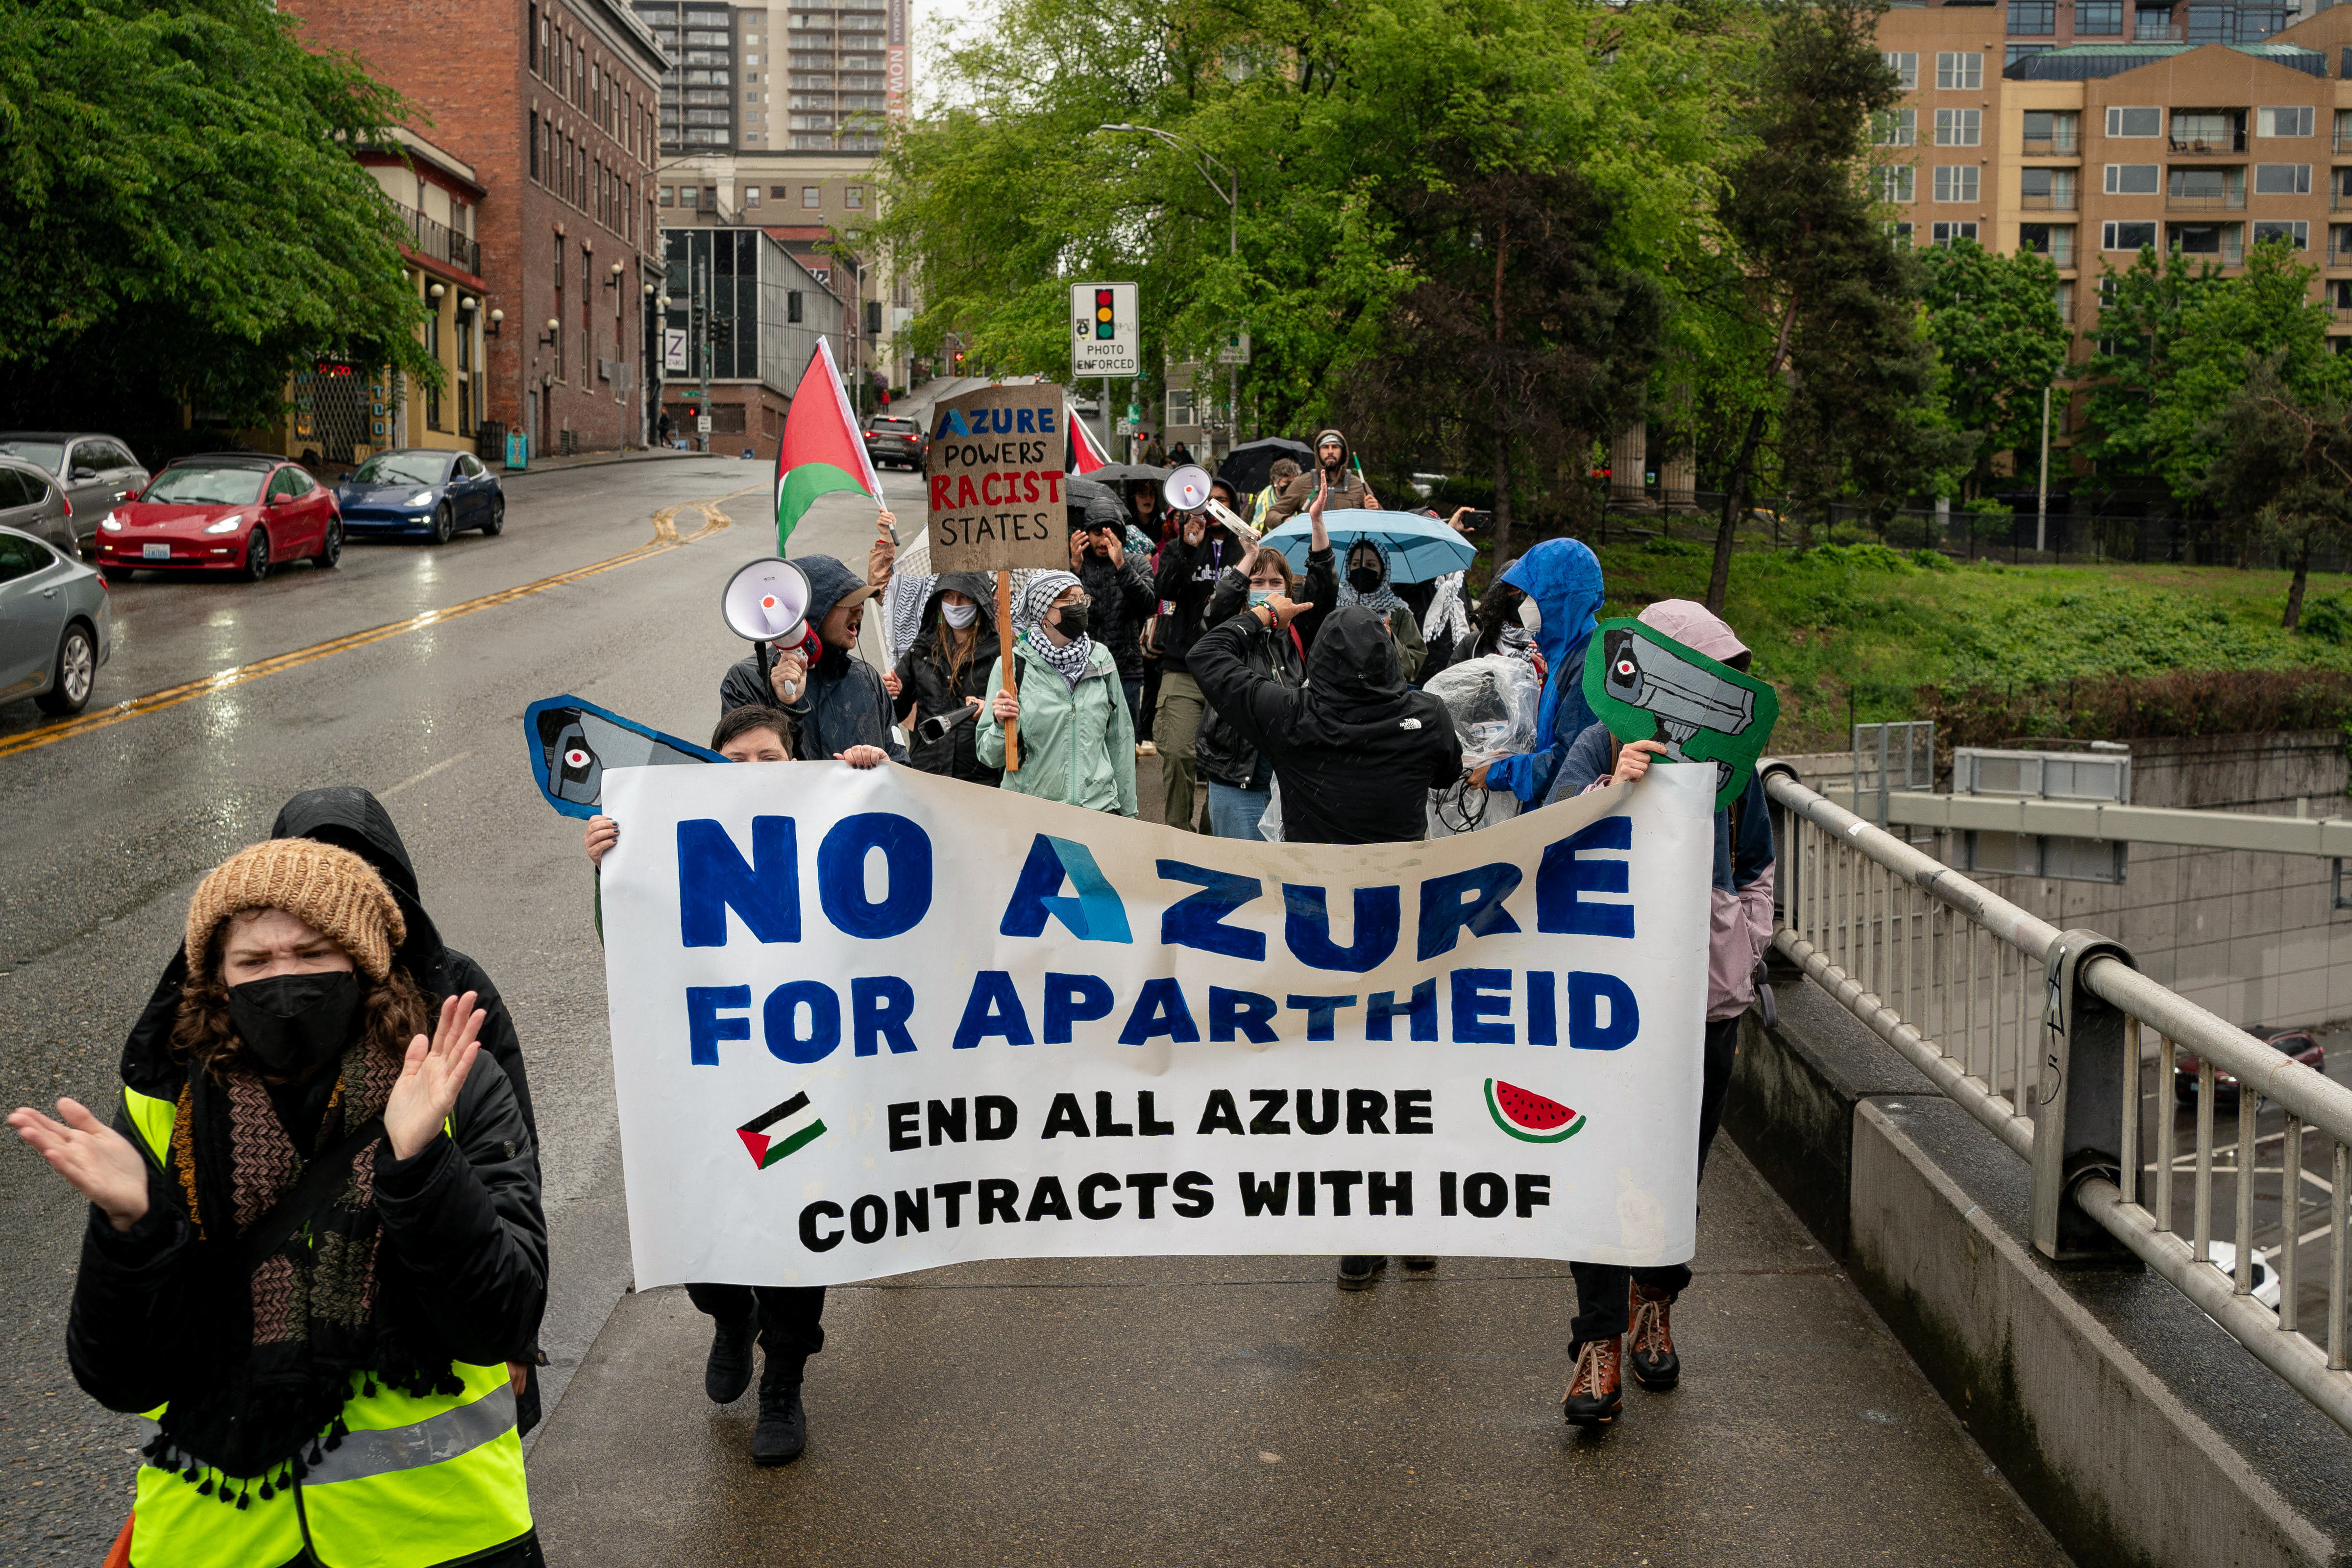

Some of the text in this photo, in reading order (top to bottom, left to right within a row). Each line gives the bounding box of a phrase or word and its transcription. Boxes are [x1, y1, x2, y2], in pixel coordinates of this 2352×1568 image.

[889, 49, 904, 93] NOW
[668, 335, 684, 356] Z
[1077, 359, 1134, 369] ENFORCED
[1087, 345, 1124, 355] PHOTO
[935, 408, 1055, 440] AZURE
[945, 441, 1047, 468] POWERS
[931, 470, 1064, 511] RACIST
[940, 513, 1048, 546] STATES
[677, 812, 1636, 972] NO AZURE
[686, 968, 1640, 1066] FOR APARTHEID
[888, 1088, 1434, 1152] END ALL AZURE
[798, 1170, 1551, 1253] CONTRACTS WITH IOF
